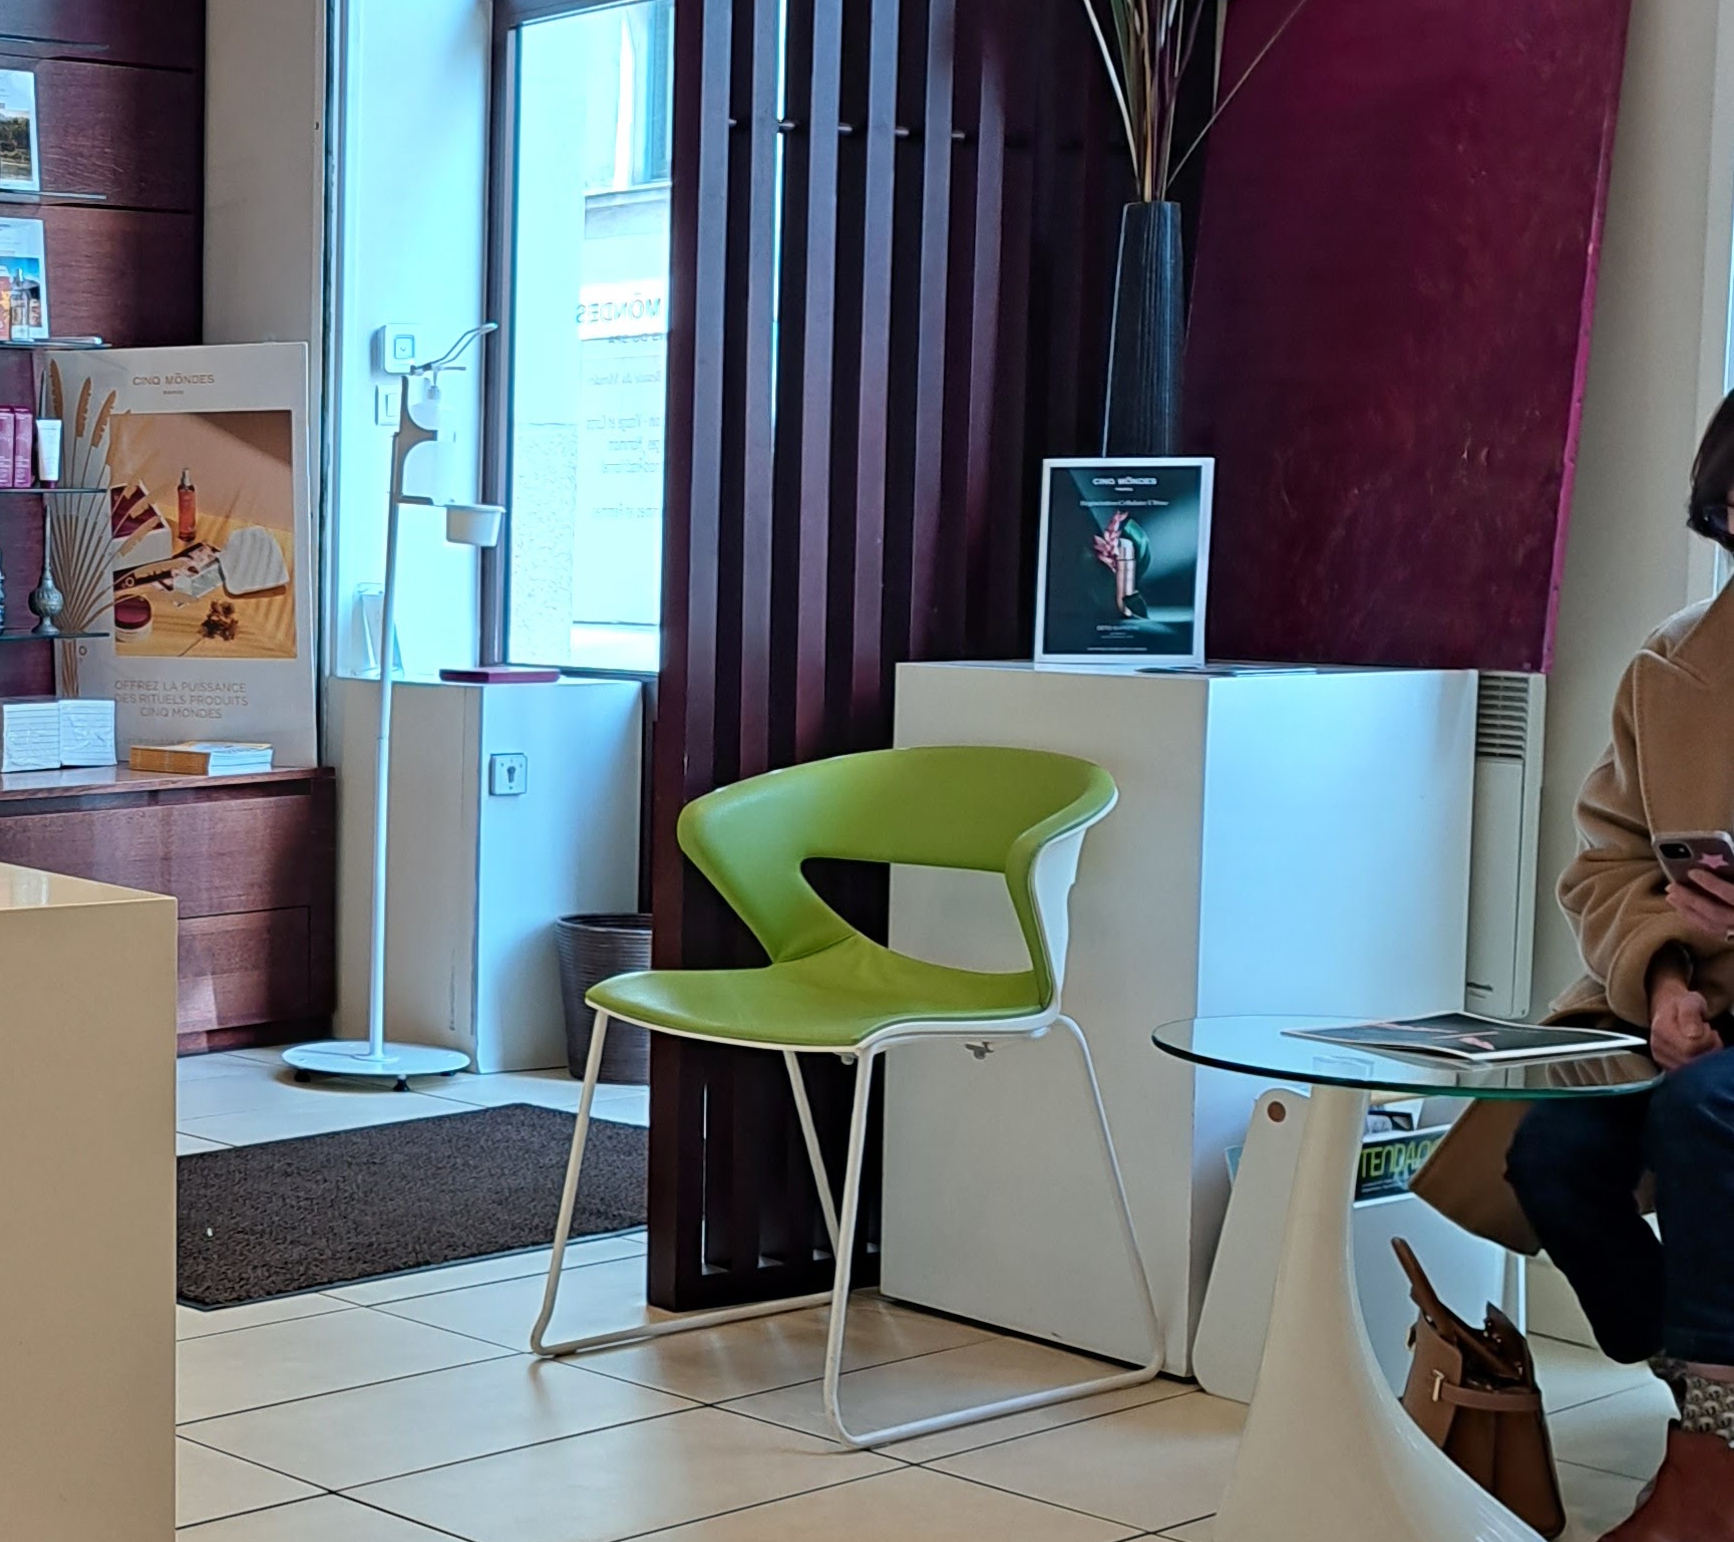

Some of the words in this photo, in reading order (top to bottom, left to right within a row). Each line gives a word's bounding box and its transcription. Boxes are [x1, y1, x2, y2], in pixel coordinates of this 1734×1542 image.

[132, 376, 160, 386] CINQ
[115, 680, 159, 692] OFFREZ
[163, 681, 178, 692] LA
[181, 682, 247, 694] PUISSANCE
[139, 693, 187, 705] RITUELS
[189, 695, 249, 707] PRODUITS
[140, 707, 169, 718] CINQ
[171, 708, 222, 719] MONDES
